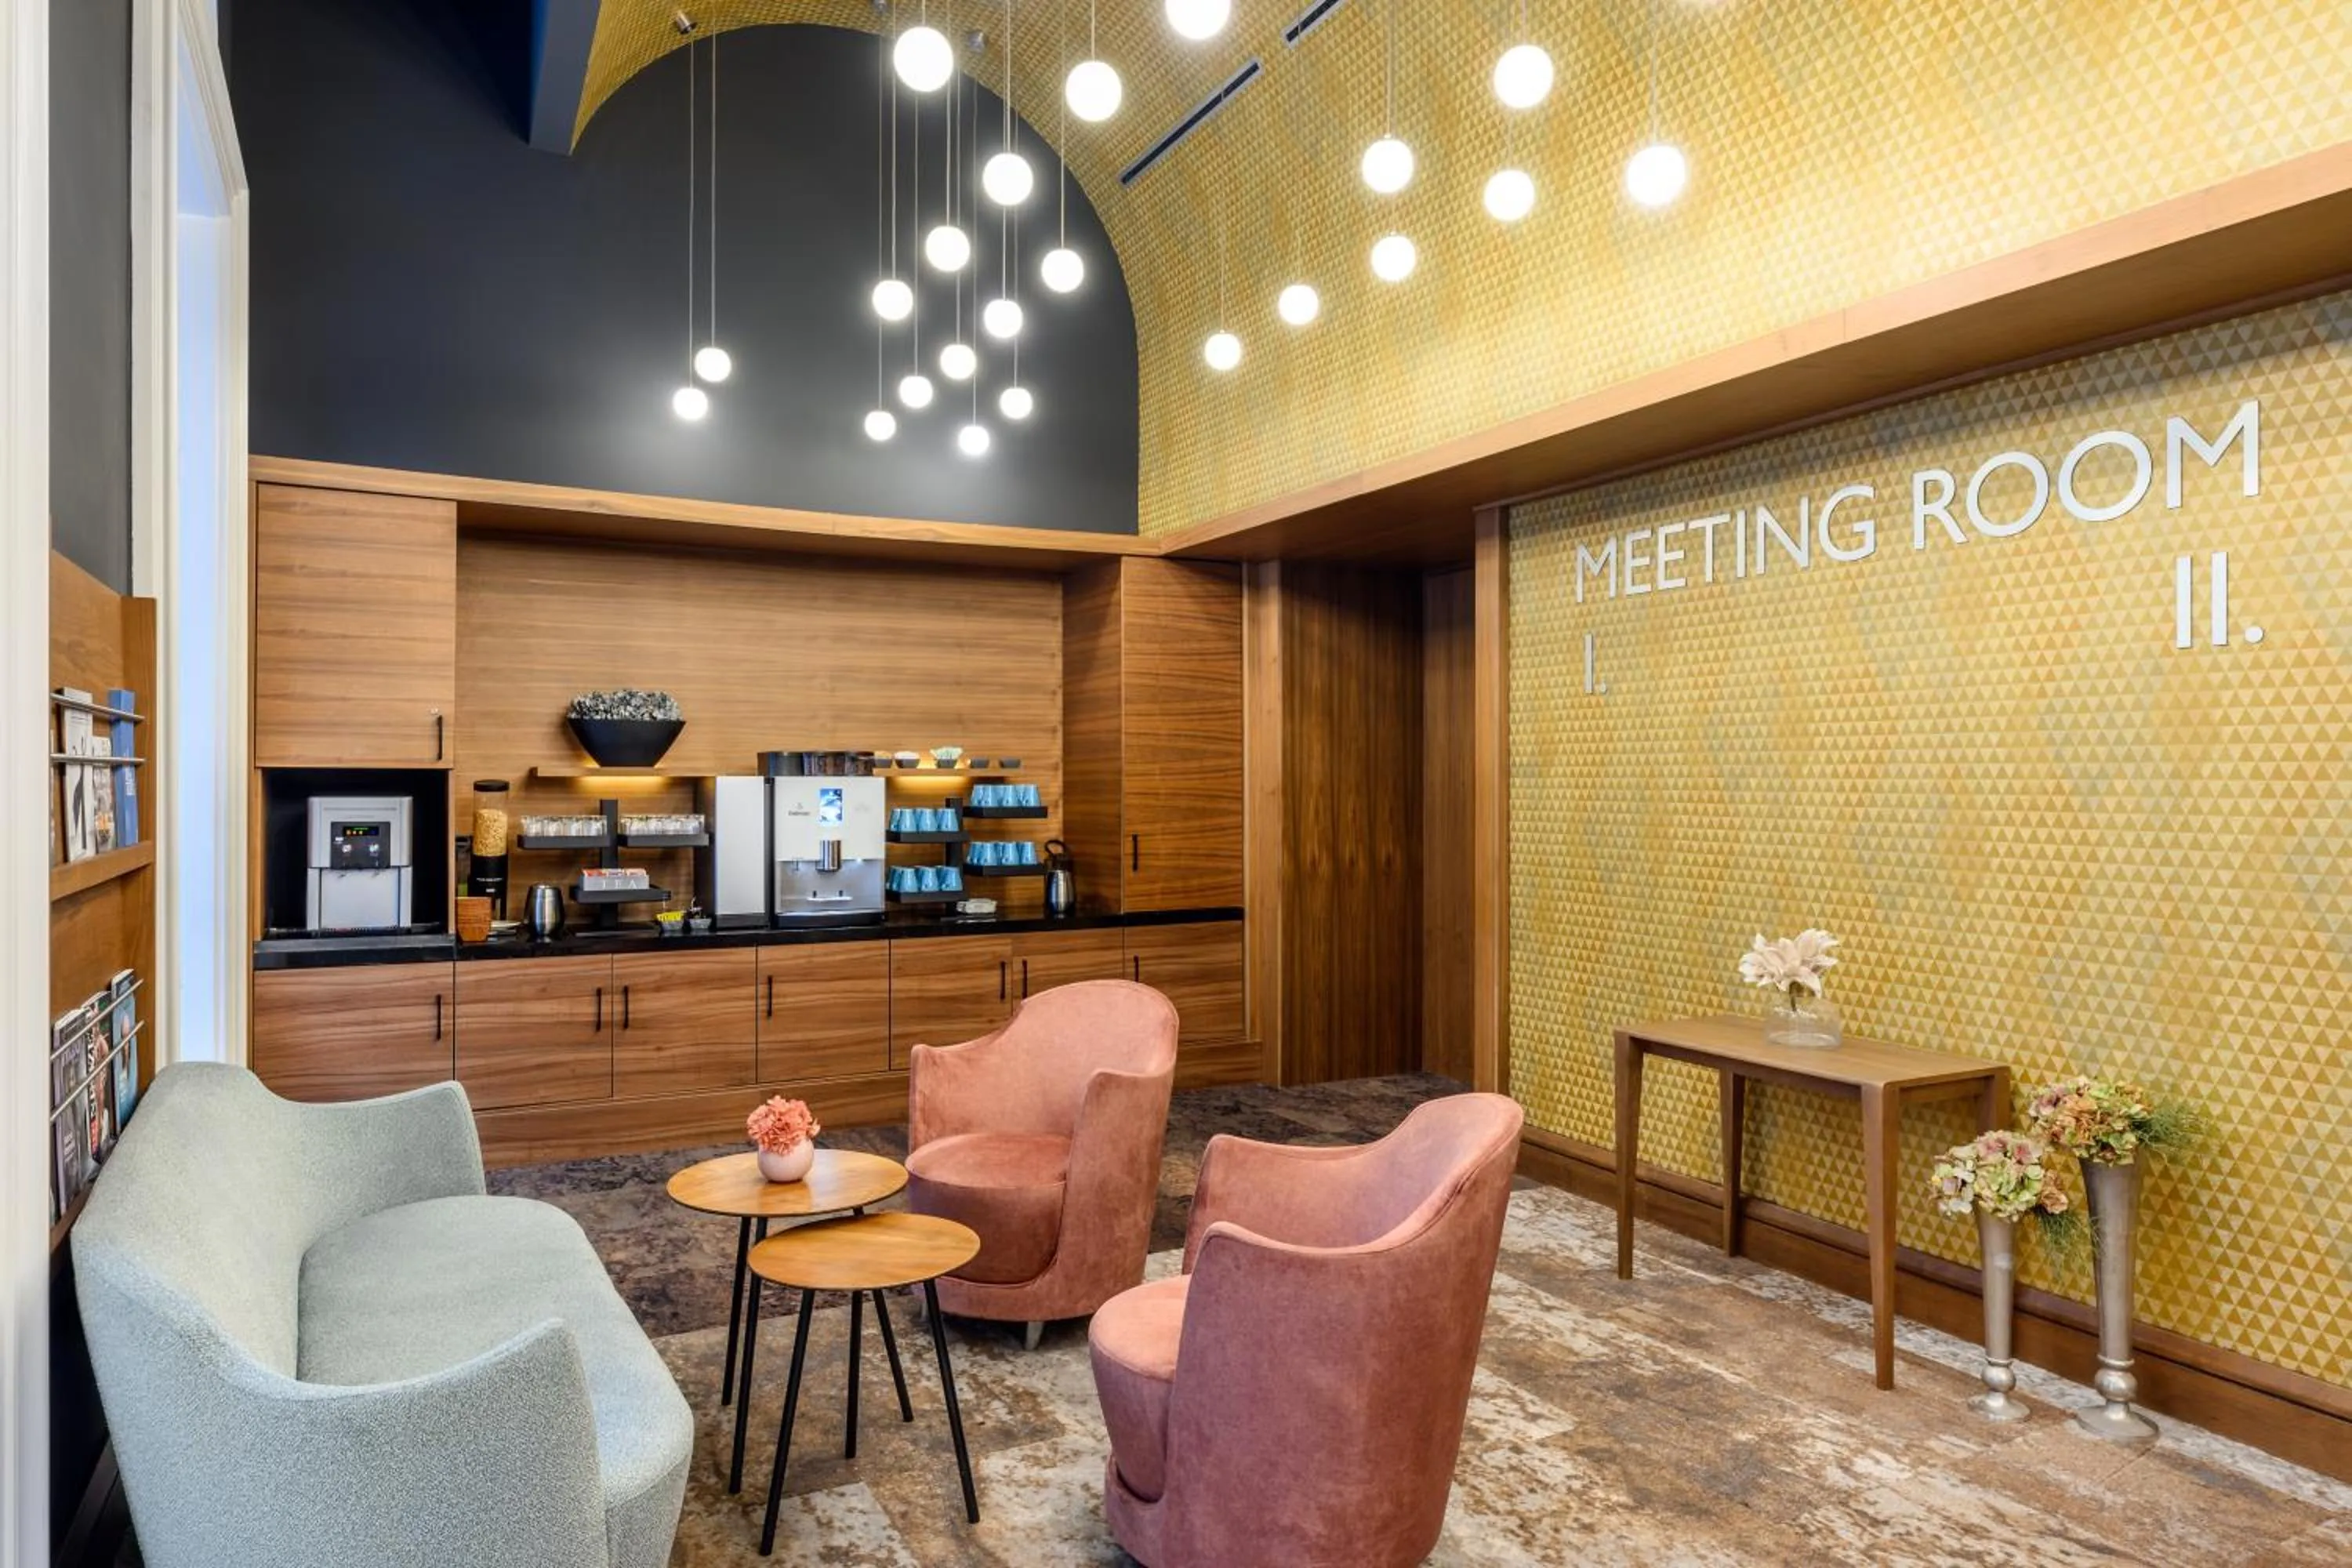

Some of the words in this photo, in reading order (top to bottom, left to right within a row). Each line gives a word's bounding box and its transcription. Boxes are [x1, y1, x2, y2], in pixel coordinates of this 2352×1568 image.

[1576, 484, 1876, 603] MEETING
[1911, 399, 2259, 550] ROOM
[2176, 551, 2264, 649] II.
[1584, 633, 1606, 694] I.
